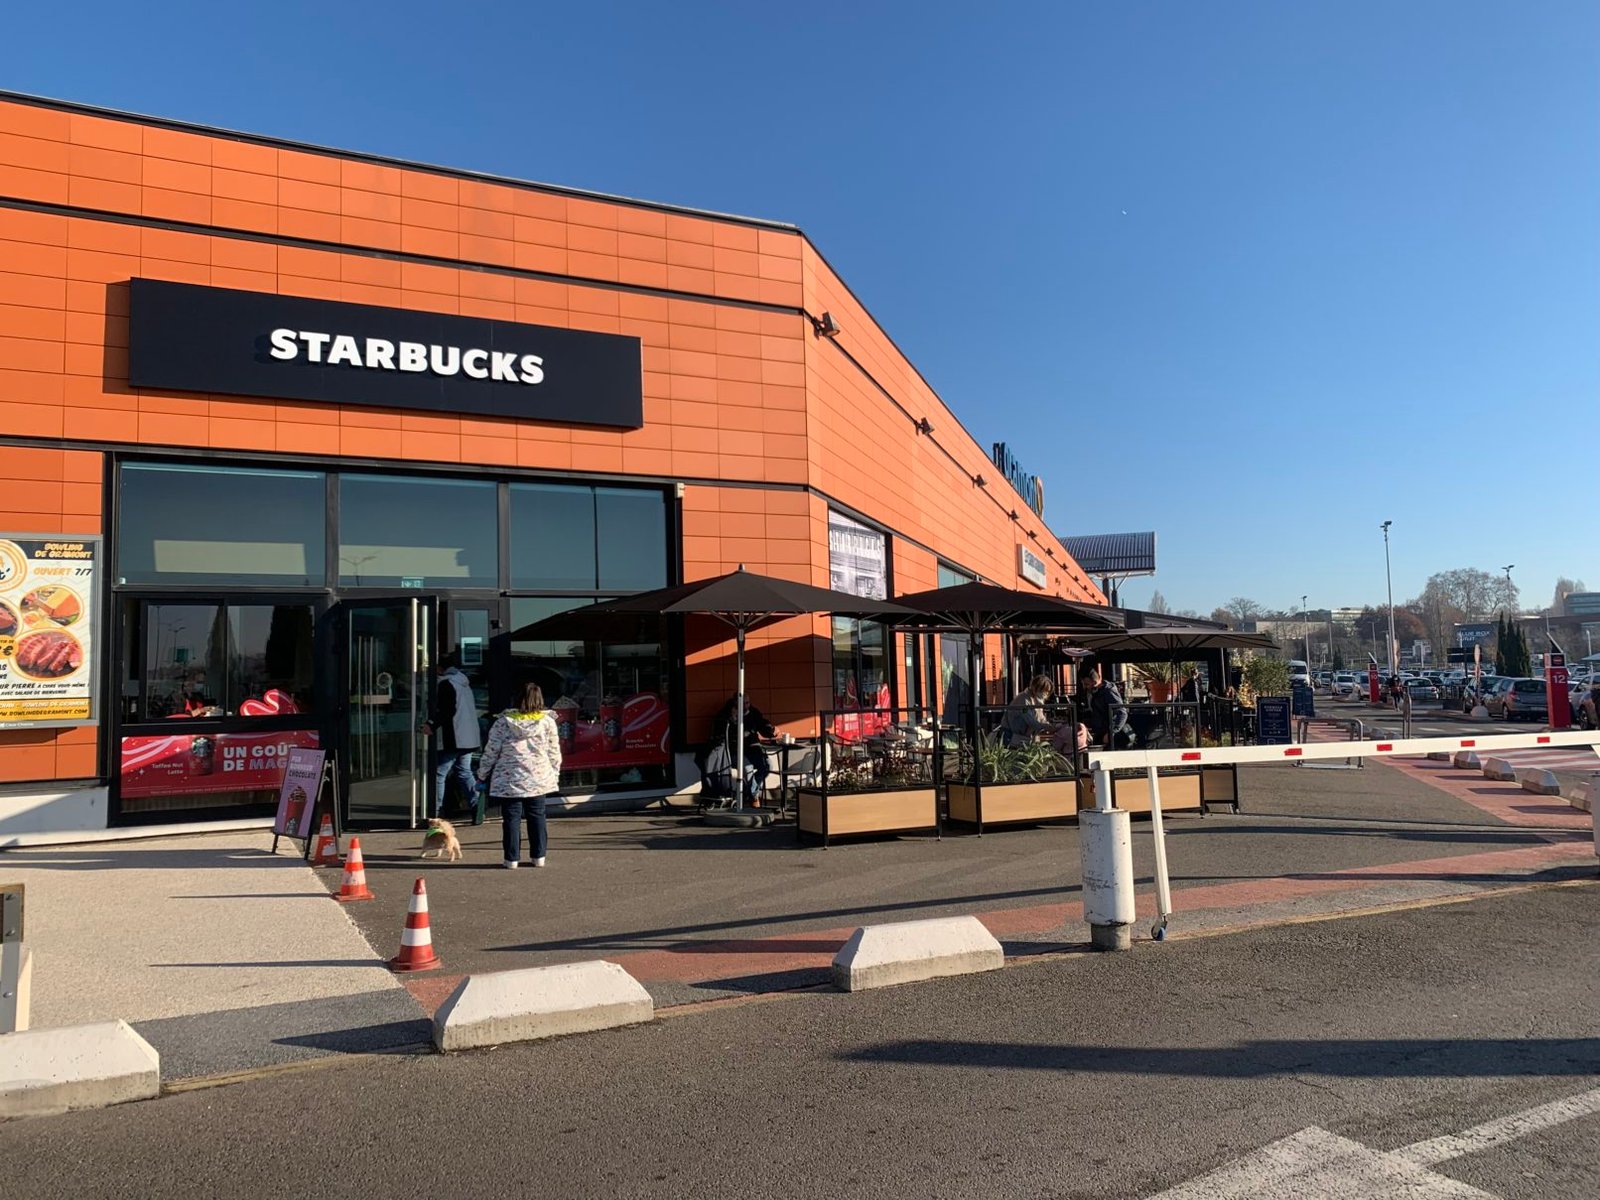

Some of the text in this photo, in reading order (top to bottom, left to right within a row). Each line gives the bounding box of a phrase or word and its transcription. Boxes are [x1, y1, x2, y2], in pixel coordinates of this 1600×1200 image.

[270, 328, 545, 384] STARBUCKS
[33, 567, 92, 576] OUVERT 7/7
[1552, 675, 1567, 684] 12
[223, 742, 298, 758] UN GOÛ
[223, 760, 245, 772] DE
